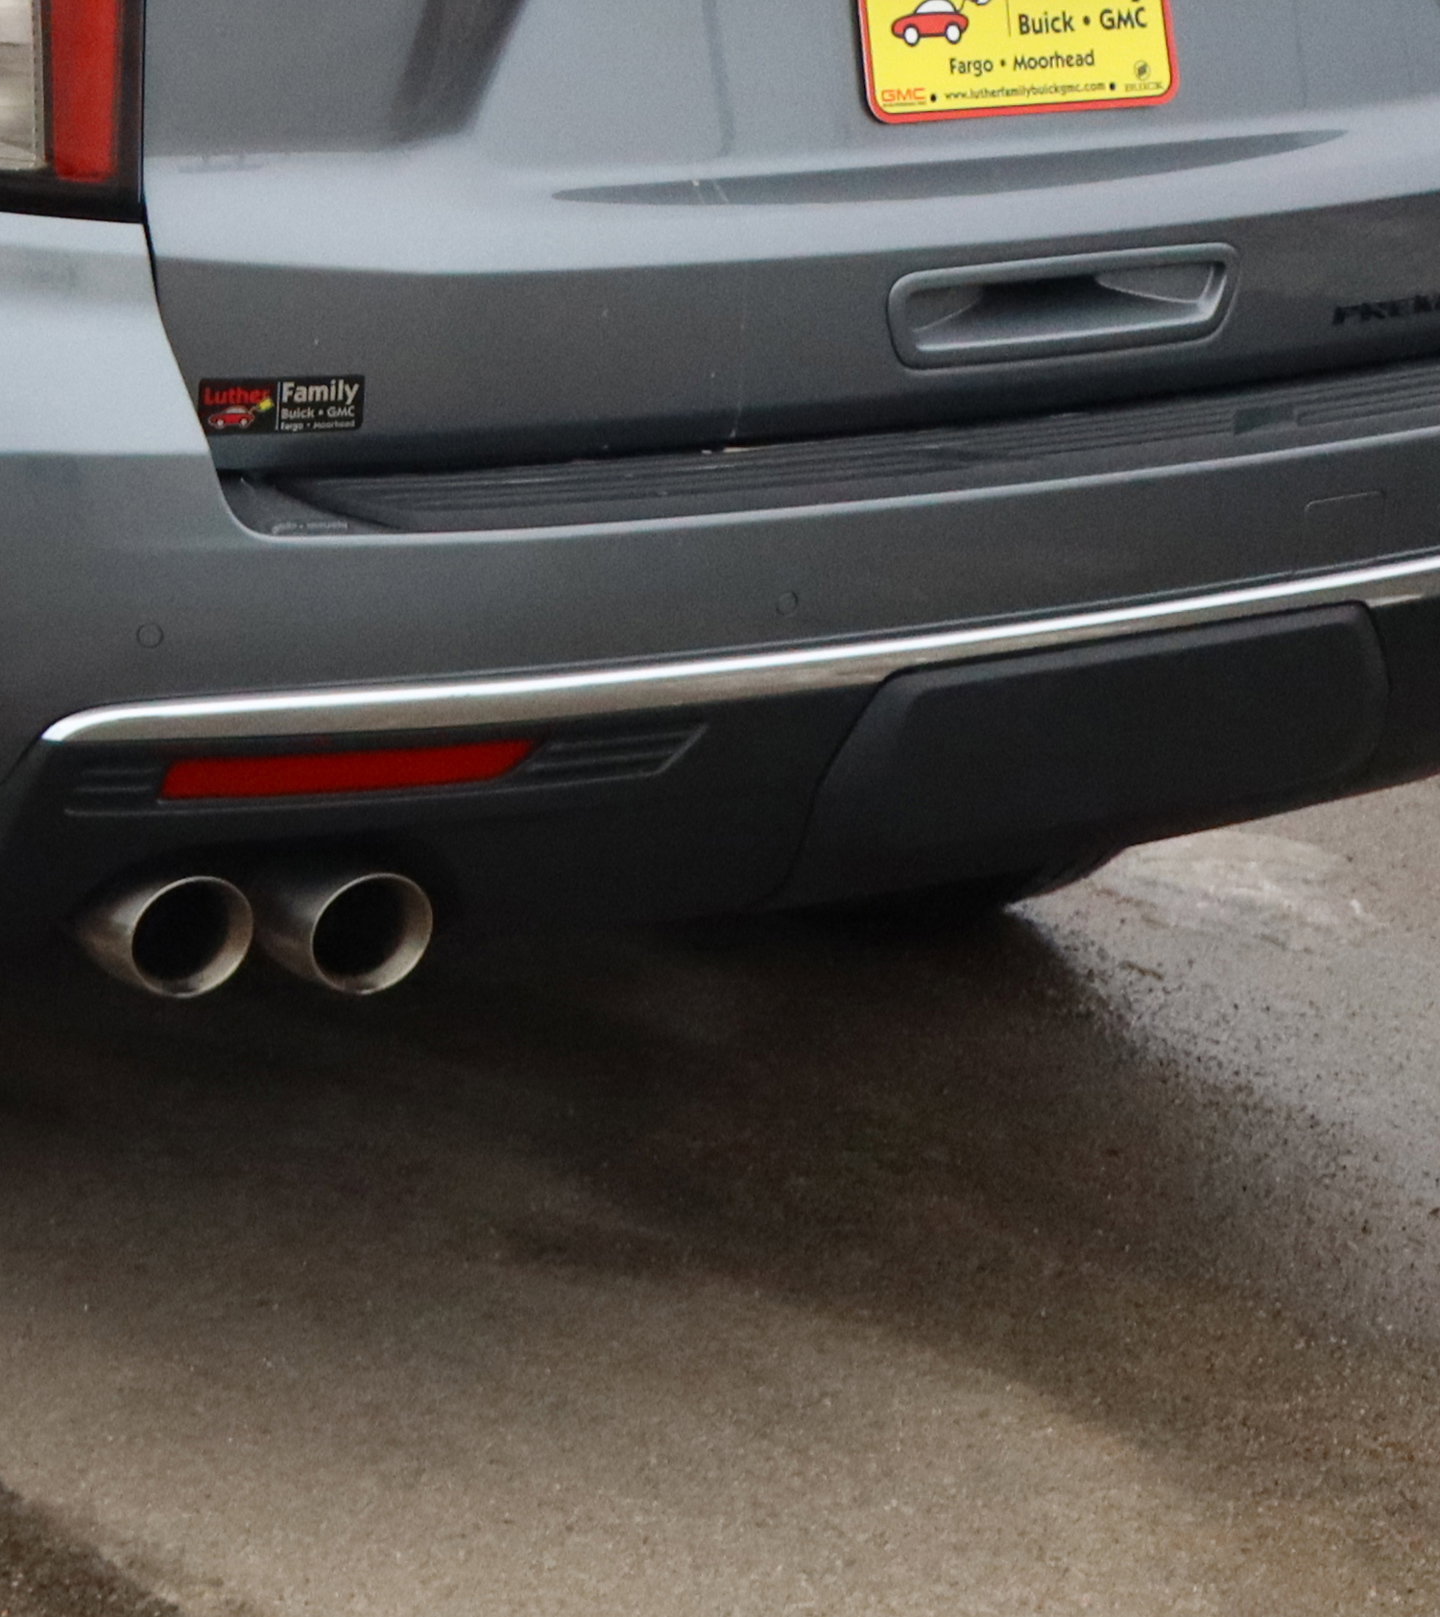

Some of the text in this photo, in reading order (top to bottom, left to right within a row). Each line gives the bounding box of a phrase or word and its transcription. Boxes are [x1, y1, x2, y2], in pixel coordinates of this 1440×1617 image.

[1019, 6, 1147, 35] Buick GMC
[949, 49, 1095, 76] Fargo Moorhead
[881, 87, 926, 102] GMC
[944, 82, 1106, 99] www.lutherfamilybuickgmc.com
[204, 379, 359, 405] Luther Family
[281, 406, 355, 420] Buick GMC
